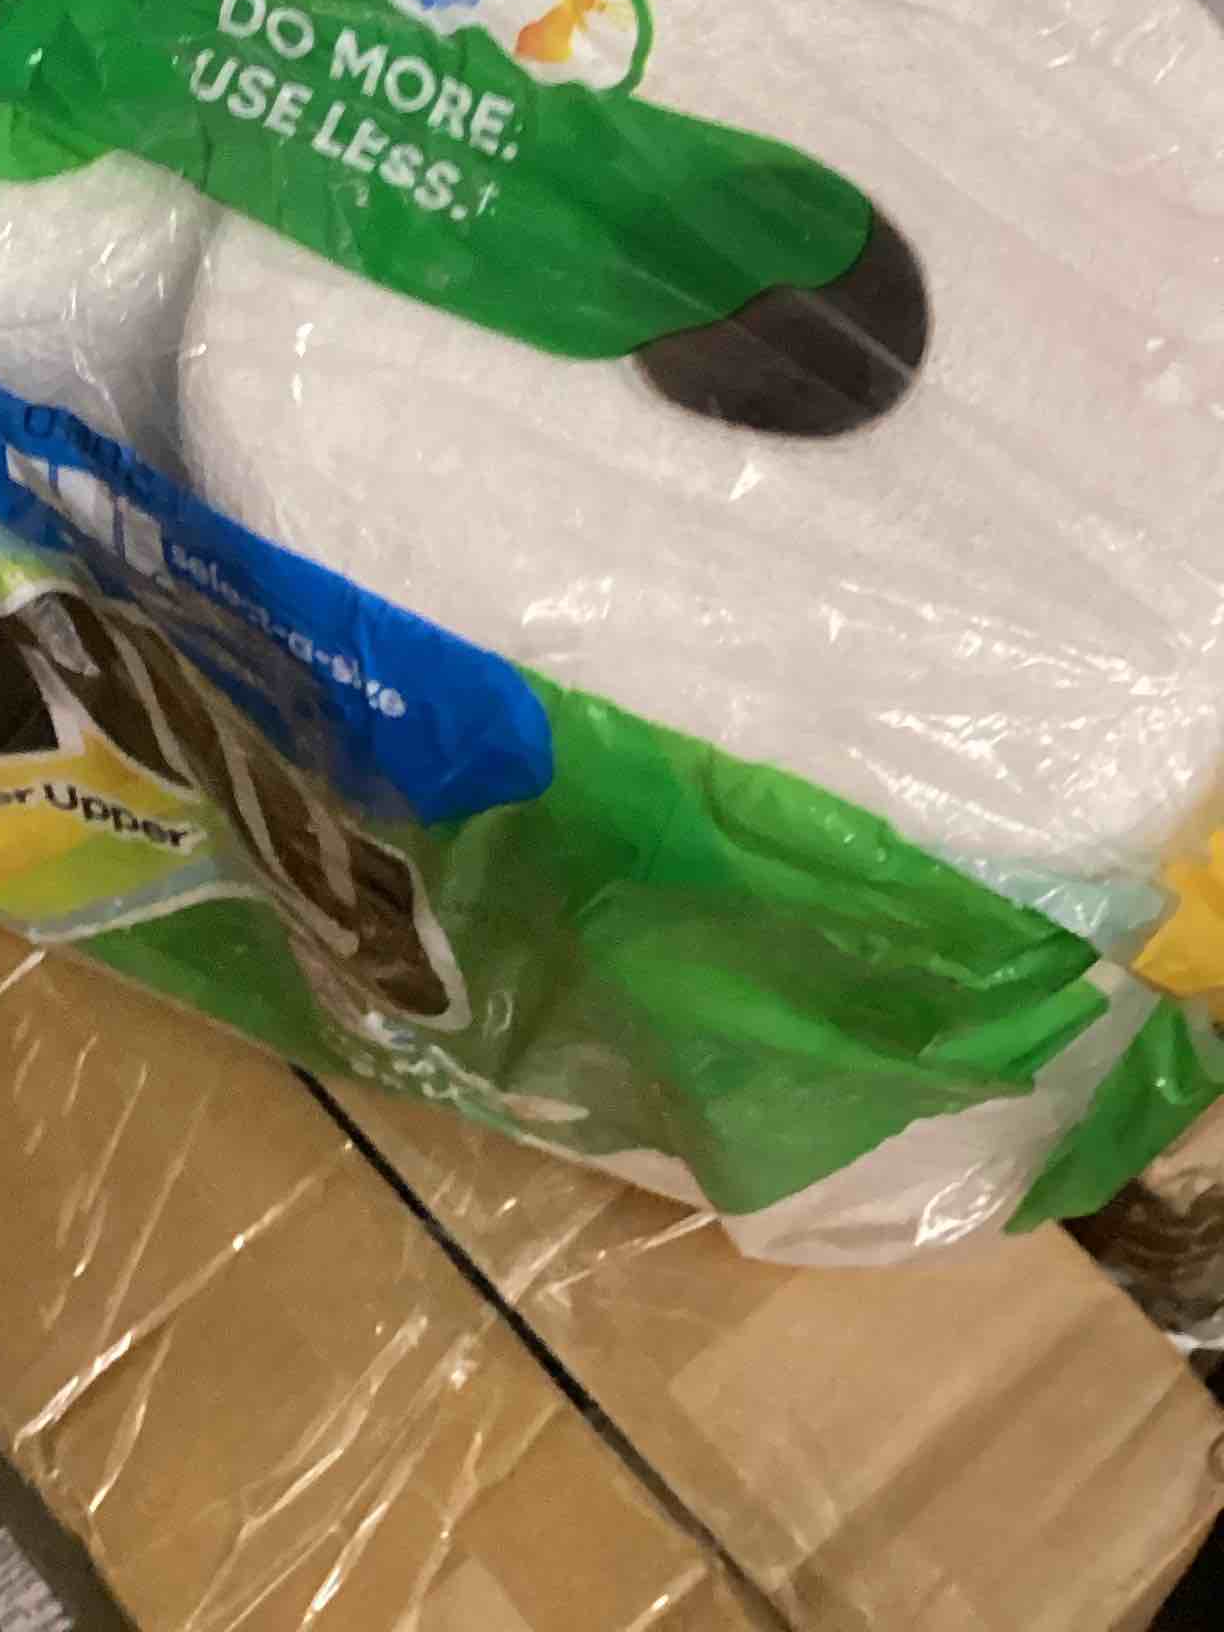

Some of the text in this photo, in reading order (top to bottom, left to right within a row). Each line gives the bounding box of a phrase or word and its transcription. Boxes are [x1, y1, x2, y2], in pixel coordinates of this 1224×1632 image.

[188, 47, 471, 223] USE LESS.
[328, 27, 520, 162] MORE.
[43, 781, 191, 848] Upper
